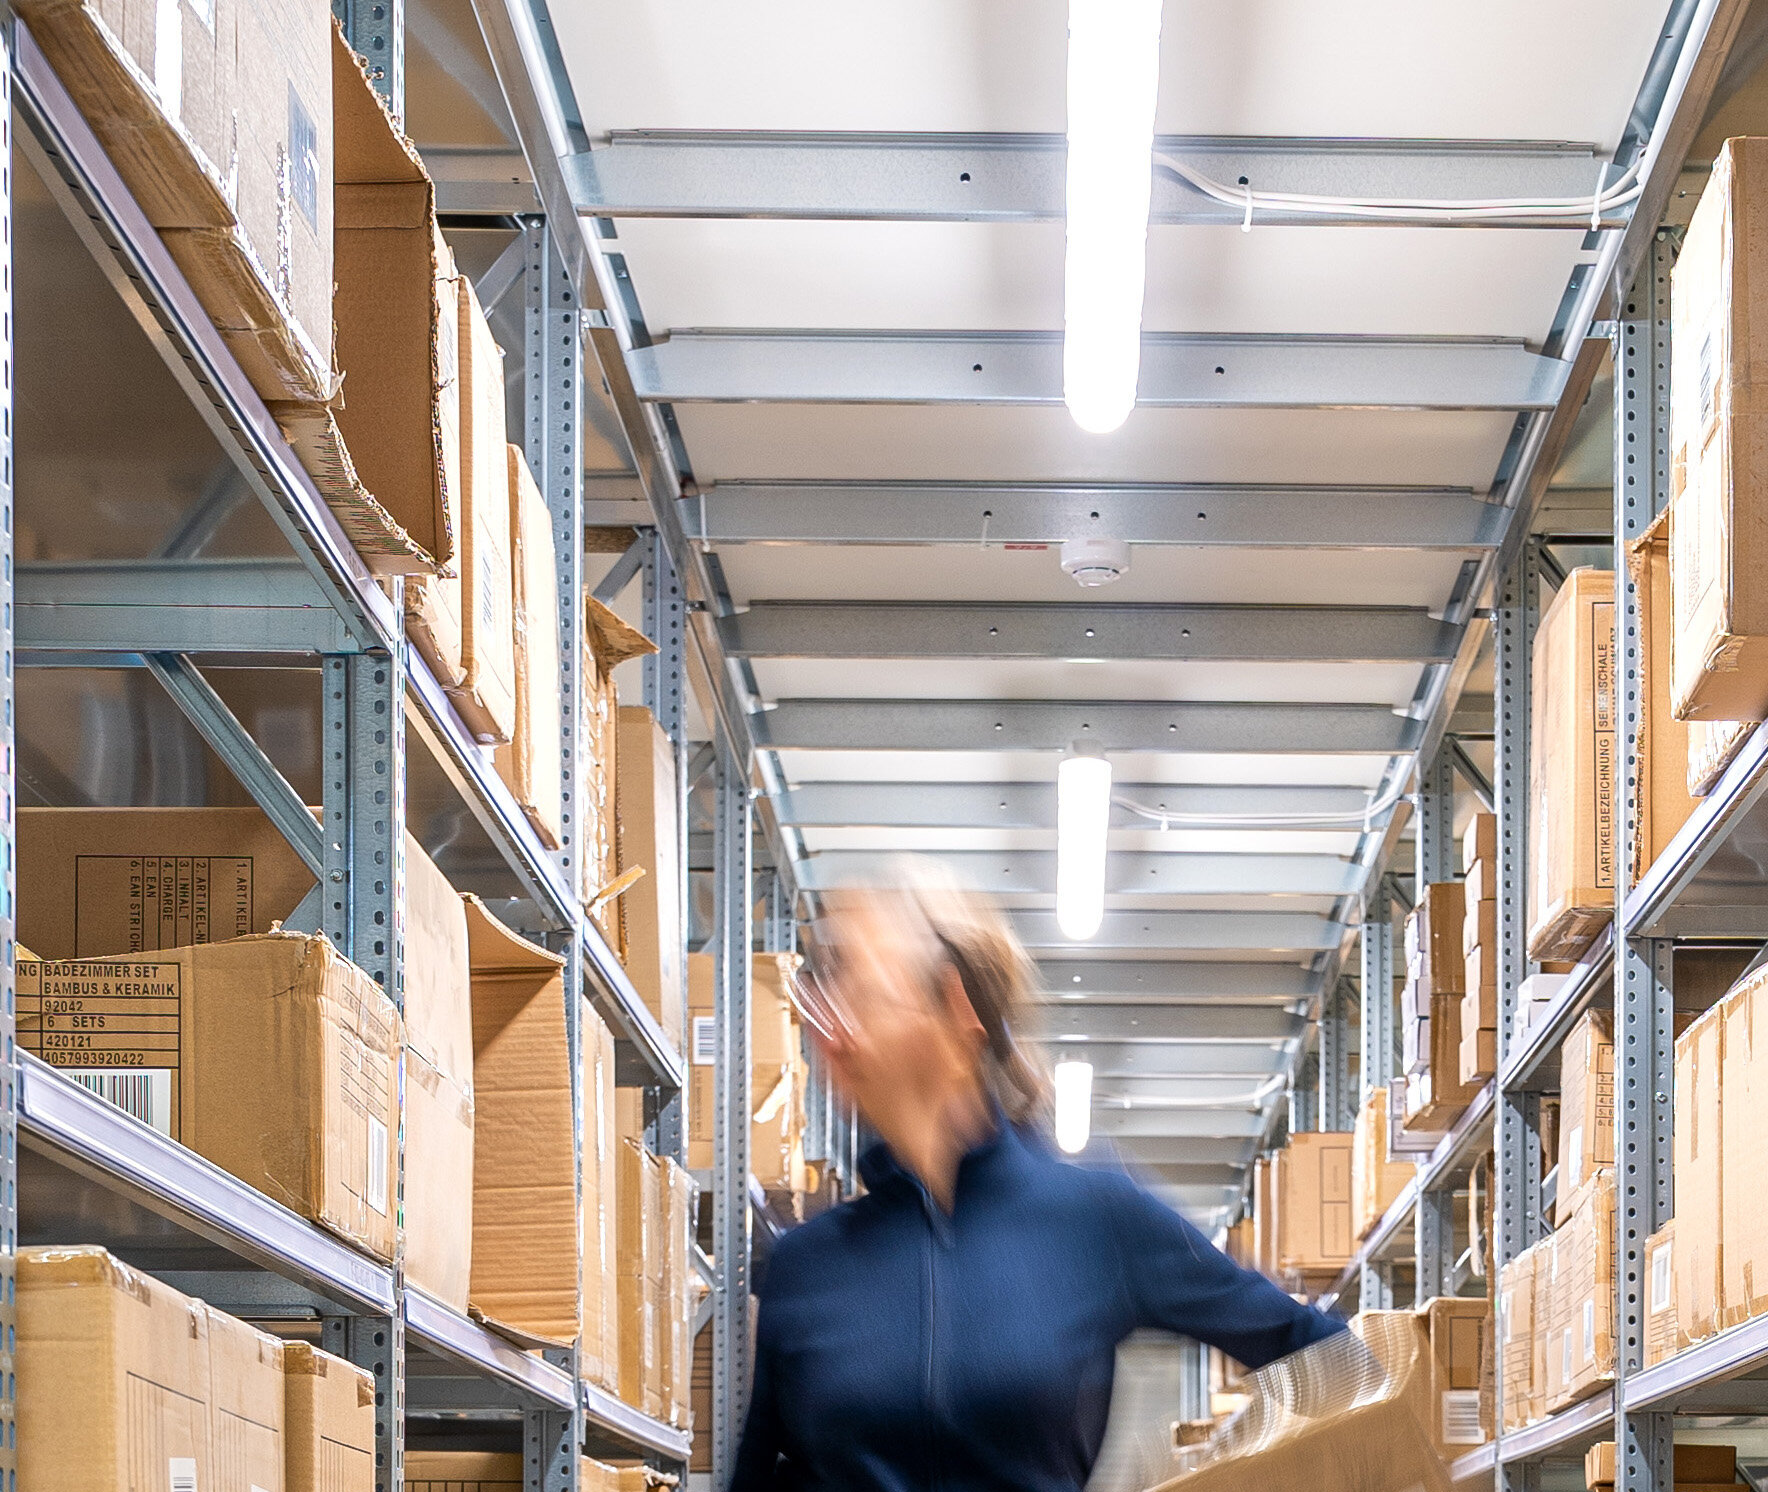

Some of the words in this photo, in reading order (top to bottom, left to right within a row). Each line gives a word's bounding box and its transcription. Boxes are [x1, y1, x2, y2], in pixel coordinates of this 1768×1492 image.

[130, 875, 142, 898] EAN
[146, 875, 158, 898] EAN
[162, 876, 174, 921] CHARGE
[178, 877, 190, 920] INHALT
[44, 964, 131, 979] BADEZIMMER
[134, 966, 160, 978] SET
[44, 982, 99, 995] BAMBUS
[102, 983, 112, 995] &
[115, 983, 176, 996] KERAMIK
[44, 1000, 84, 1013] 92042
[46, 1016, 55, 1028] 6
[71, 1016, 106, 1028] SETS
[45, 1035, 92, 1048] 420121
[43, 1052, 145, 1066] 4057993920422
